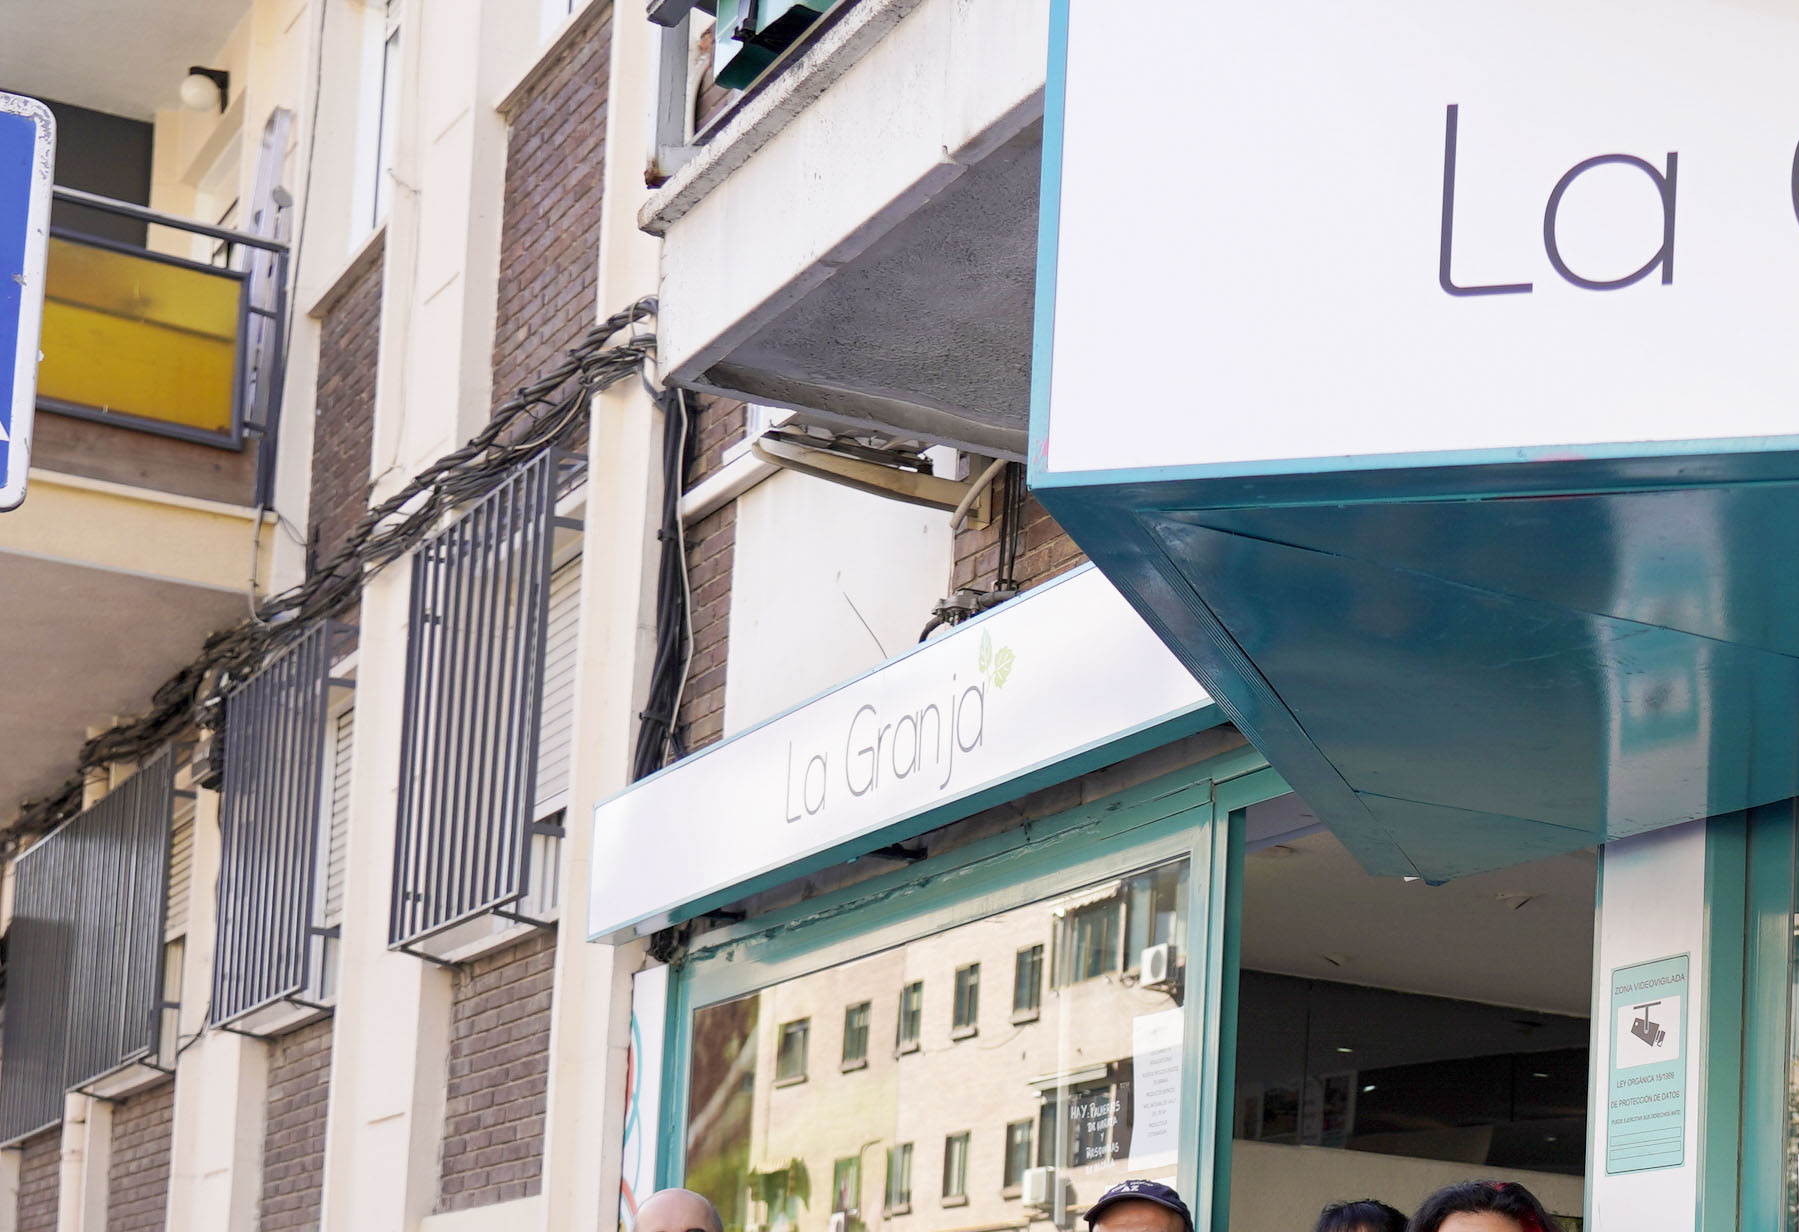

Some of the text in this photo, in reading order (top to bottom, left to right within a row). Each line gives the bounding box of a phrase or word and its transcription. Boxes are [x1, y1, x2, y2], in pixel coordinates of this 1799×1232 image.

[1438, 102, 1679, 297] La
[786, 673, 986, 824] La Granja
[1614, 973, 1685, 995] ZONA VIDEOVIGILADA
[1616, 1079, 1627, 1088] LEY
[1610, 1100, 1618, 1109] DE
[1661, 1089, 1680, 1100] DATOS
